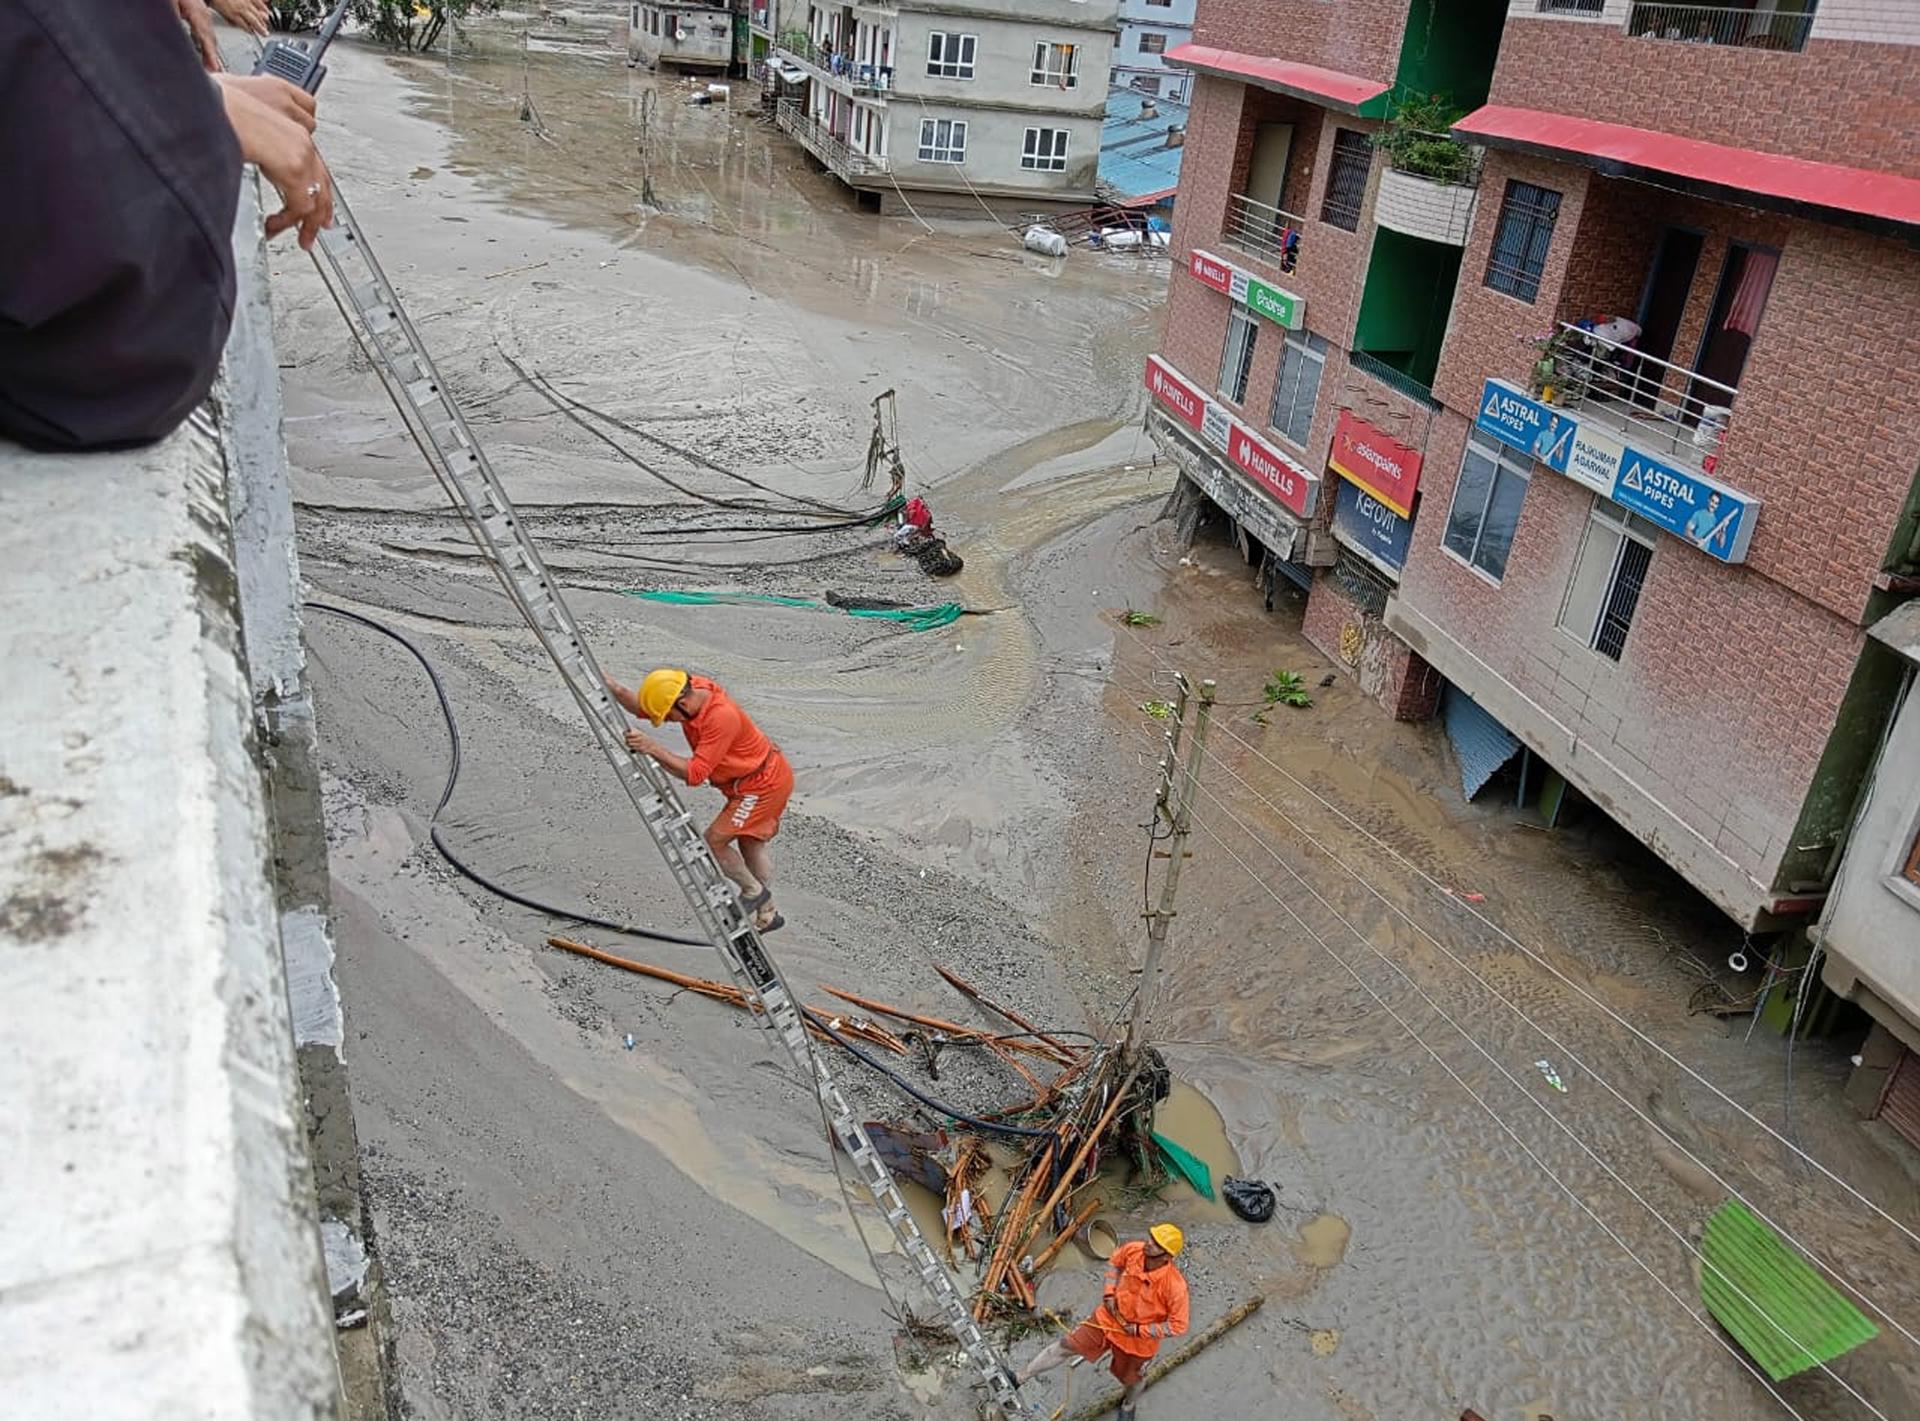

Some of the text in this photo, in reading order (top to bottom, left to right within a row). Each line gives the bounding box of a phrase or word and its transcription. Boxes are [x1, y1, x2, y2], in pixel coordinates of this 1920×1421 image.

[1501, 398, 1540, 427] ASTRAL
[1501, 412, 1525, 432] PIPES
[1574, 454, 1610, 479] AGARWAL
[1575, 440, 1618, 469] RAJKUMAR
[1251, 451, 1294, 496] HAVELLS
[1644, 467, 1696, 506] ASTRAL
[1644, 486, 1675, 510] PIPES
